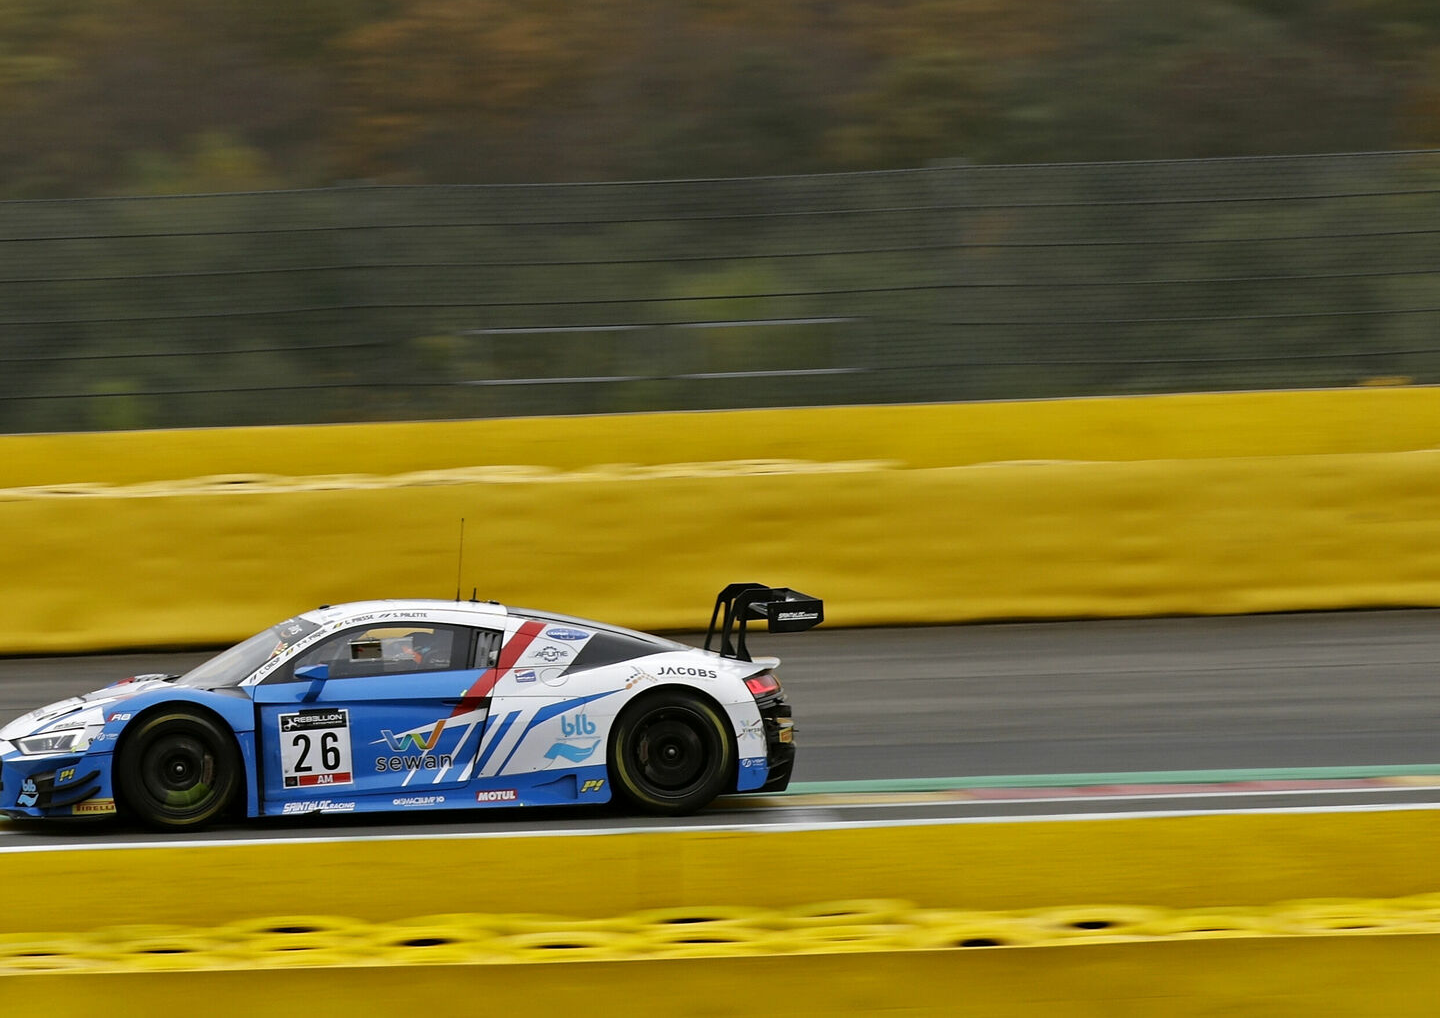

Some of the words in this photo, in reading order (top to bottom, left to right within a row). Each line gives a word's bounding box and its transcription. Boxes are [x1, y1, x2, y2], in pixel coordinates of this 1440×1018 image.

[657, 666, 717, 679] JACOBS
[561, 714, 596, 736] blb
[292, 732, 341, 773] 26
[375, 754, 454, 772] sewan
[317, 775, 333, 784] AM
[477, 791, 516, 802] MOTUL
[75, 802, 115, 811] PIRELLI
